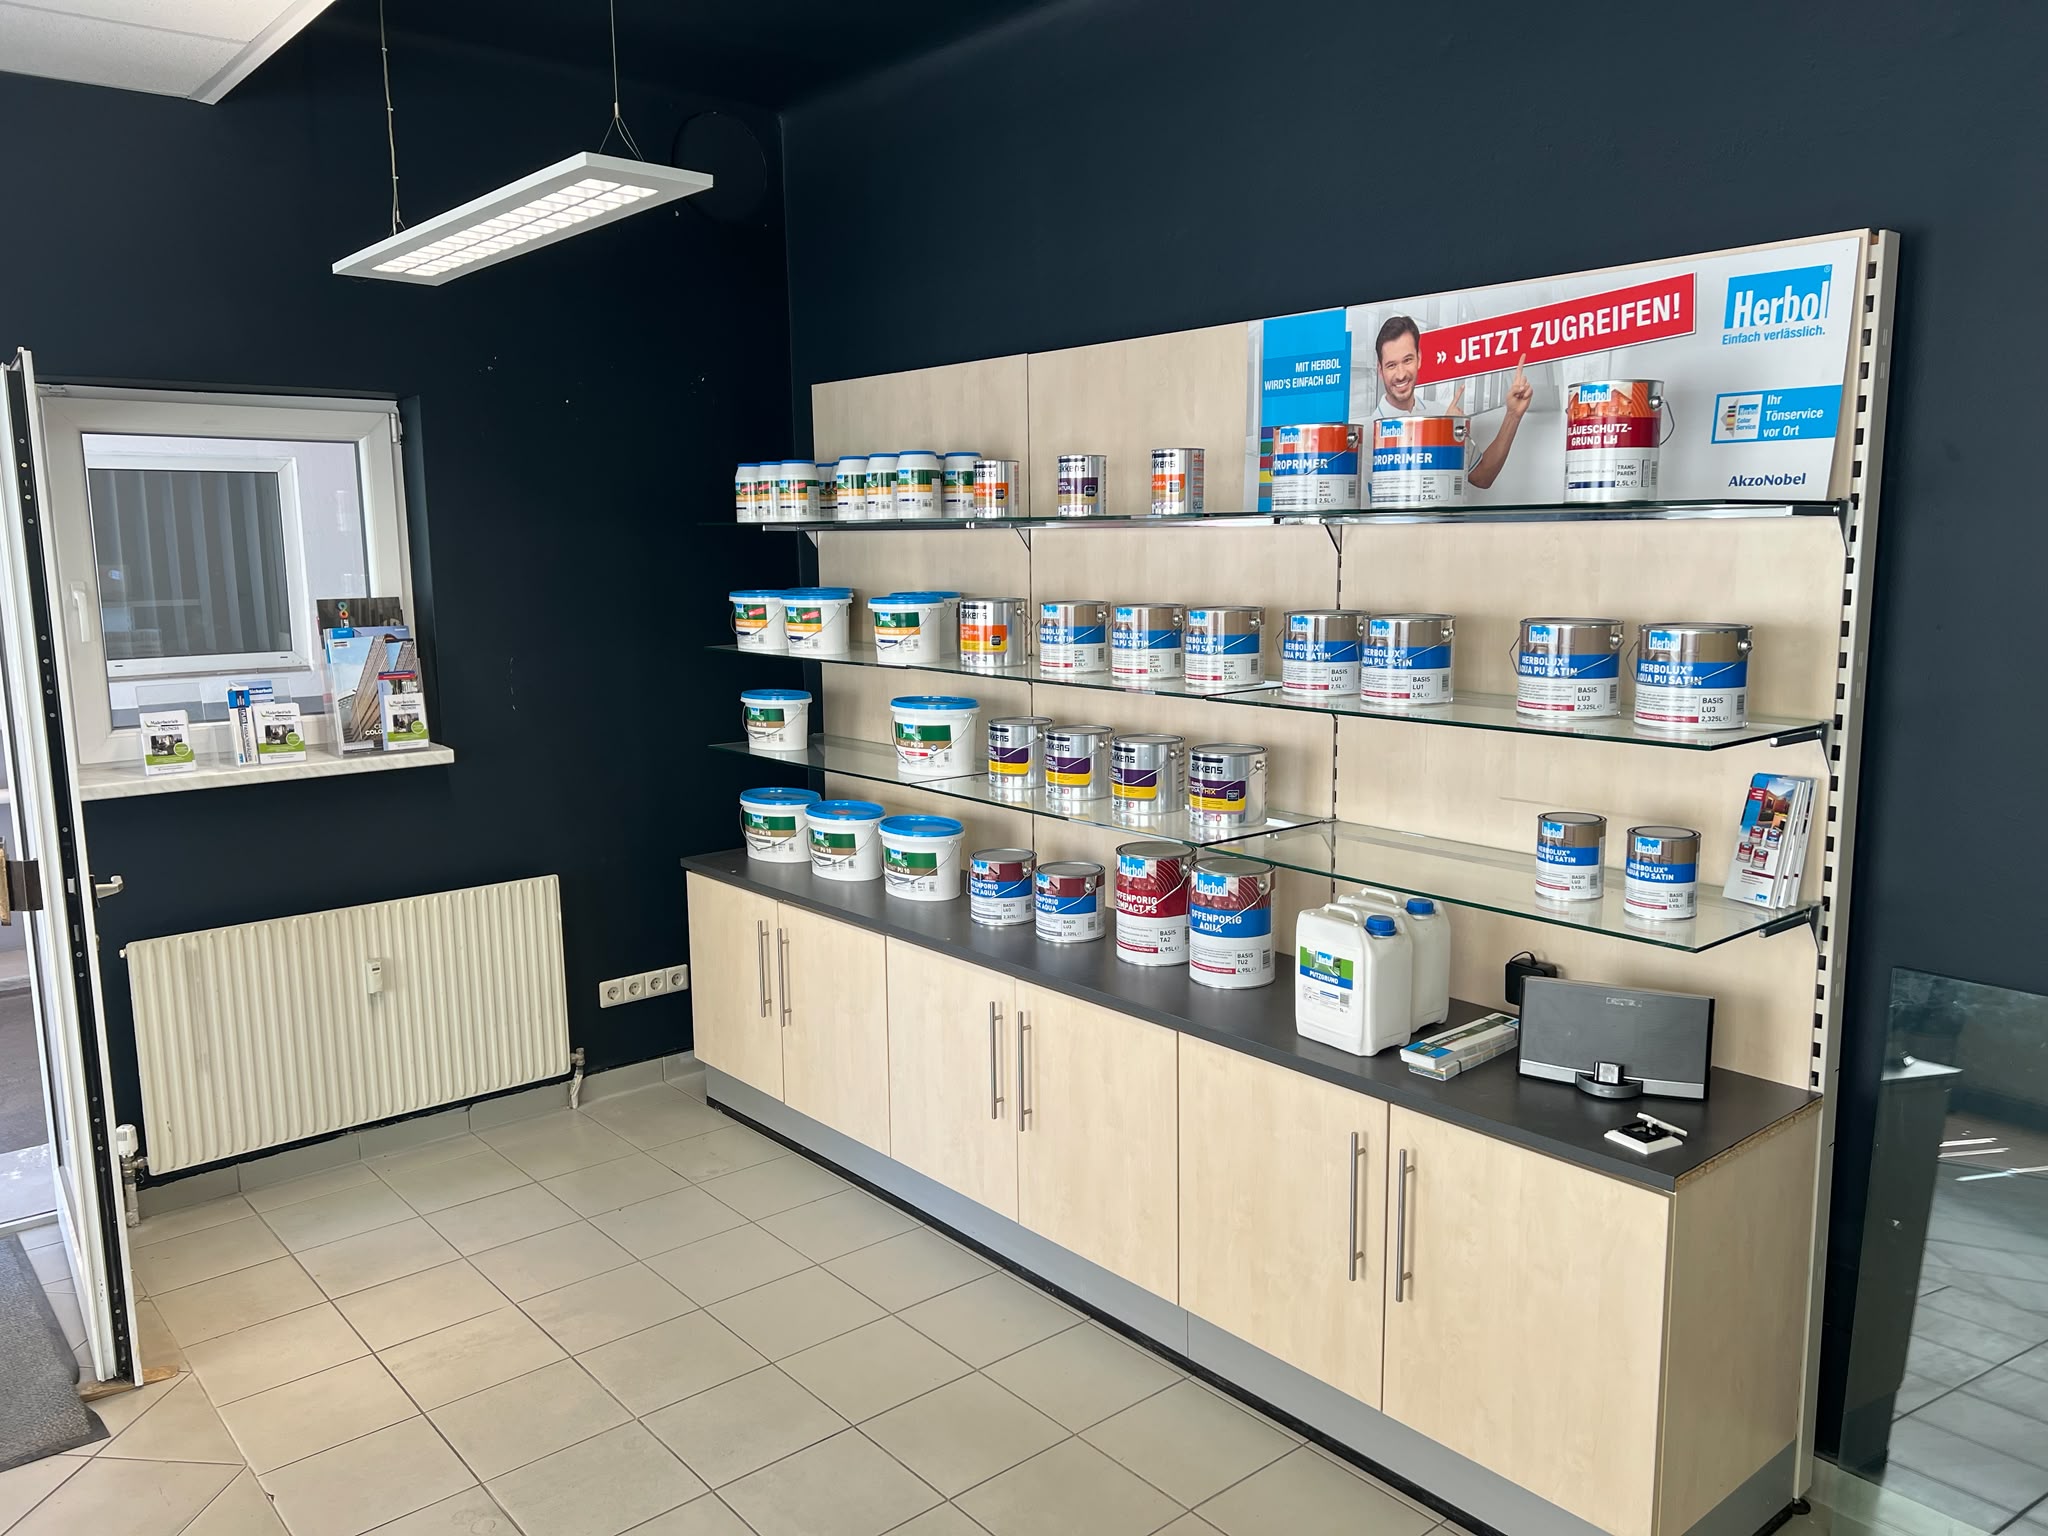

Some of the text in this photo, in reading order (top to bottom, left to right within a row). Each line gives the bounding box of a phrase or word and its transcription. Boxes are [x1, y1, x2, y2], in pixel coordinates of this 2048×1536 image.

[1732, 281, 1830, 329] Herbol
[1454, 292, 1681, 364] JETZT ZUGREIFEN!
[1722, 325, 1825, 345] Einfach verlässlich.
[1295, 359, 1341, 373] MIT HERBOL
[1264, 373, 1341, 391] WIRD'S EINFACH GUT
[1582, 384, 1610, 402] Herbol
[1767, 394, 1782, 406] Ihr
[1737, 417, 1751, 425] Color
[1765, 408, 1823, 422] Tönservice
[1736, 424, 1756, 432] Service
[1763, 425, 1799, 438] vor Ort
[1571, 434, 1618, 446] GRUND LH
[1728, 472, 1806, 487] AkzoNobel
[1652, 636, 1679, 648] Herbol
[1374, 658, 1384, 666] PU
[1386, 658, 1412, 667] SATIN
[1534, 665, 1545, 674] PU
[1547, 667, 1578, 677] SATIN
[1654, 674, 1666, 684] PU
[1668, 676, 1702, 686] SATIN
[1121, 861, 1146, 876] Herbol
[1199, 879, 1226, 895] Herbol
[1042, 903, 1056, 912] AQUA
[1199, 922, 1222, 933] AQUA
[1309, 970, 1339, 985] PUTZGRUND
